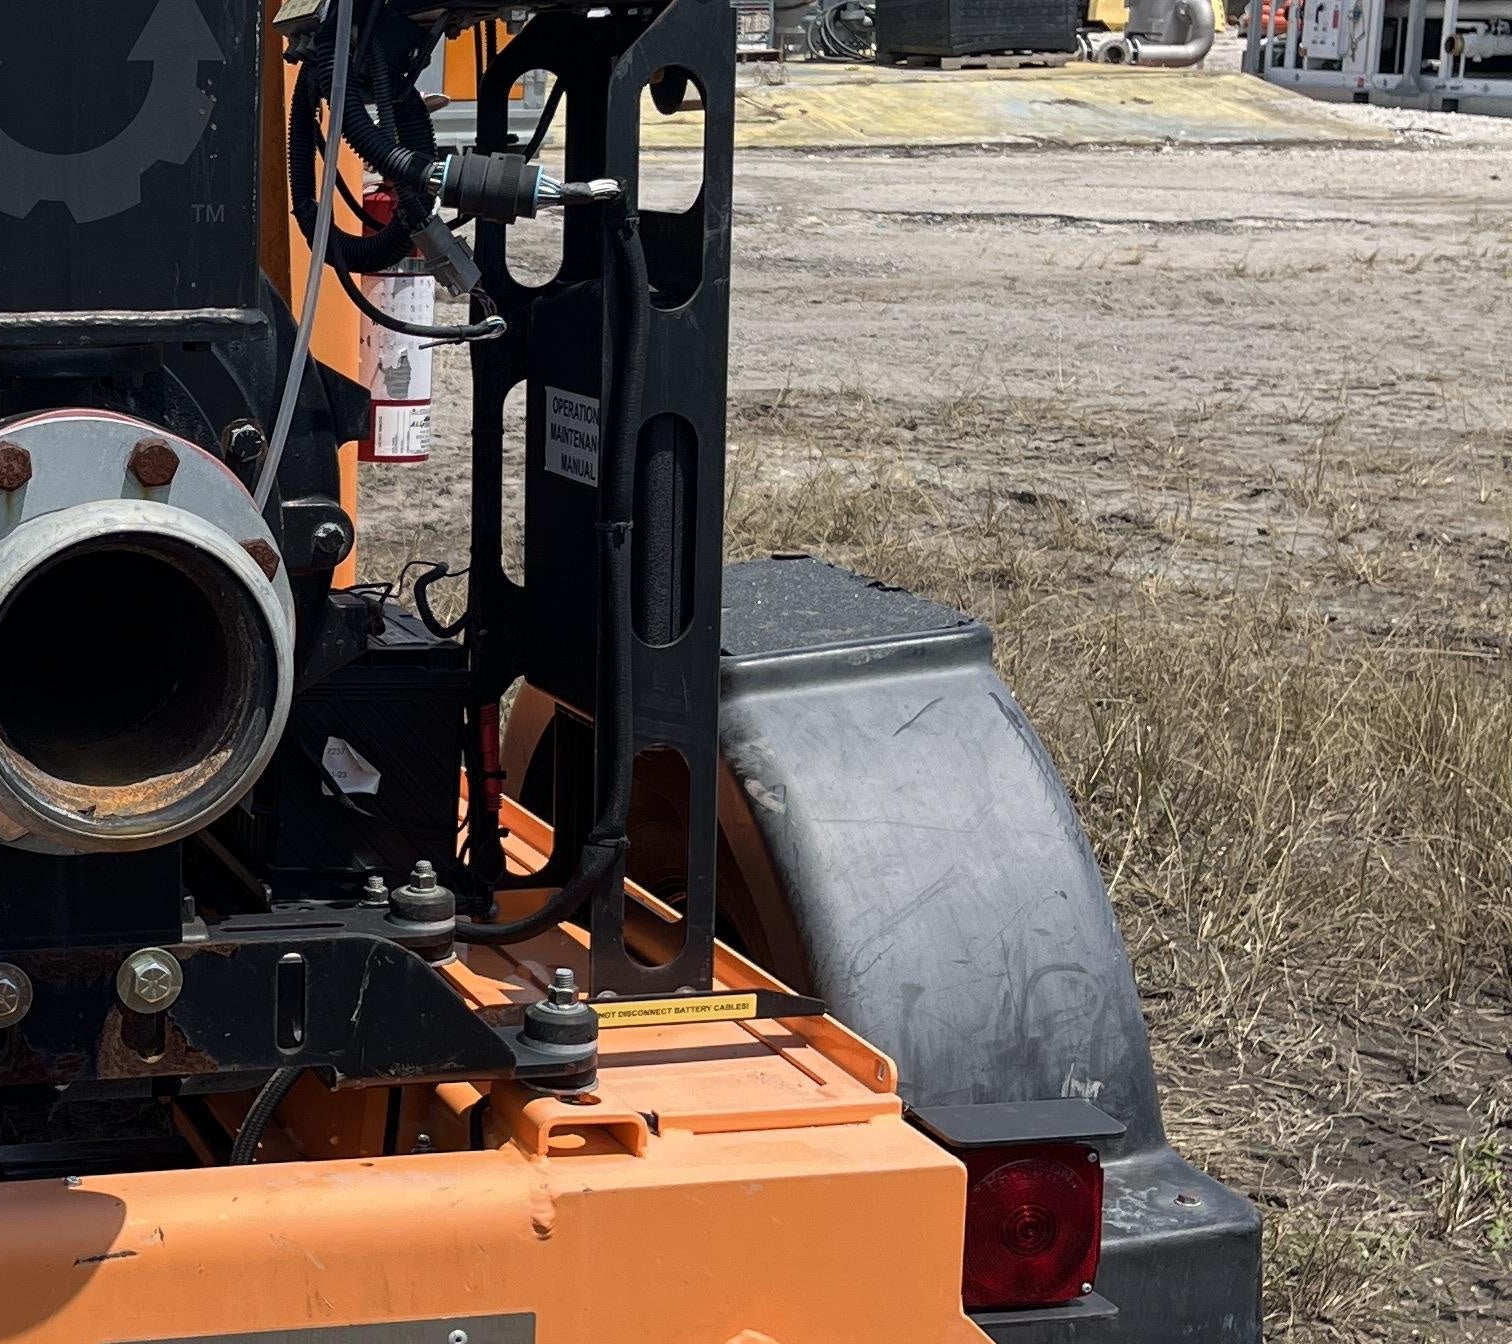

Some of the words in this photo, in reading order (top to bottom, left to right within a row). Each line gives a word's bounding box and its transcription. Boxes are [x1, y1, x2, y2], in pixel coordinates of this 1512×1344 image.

[191, 203, 225, 223] TM
[560, 453, 596, 481] MANUAL
[617, 1008, 673, 1018] DISCONNECT
[674, 1005, 712, 1014] BATTERY
